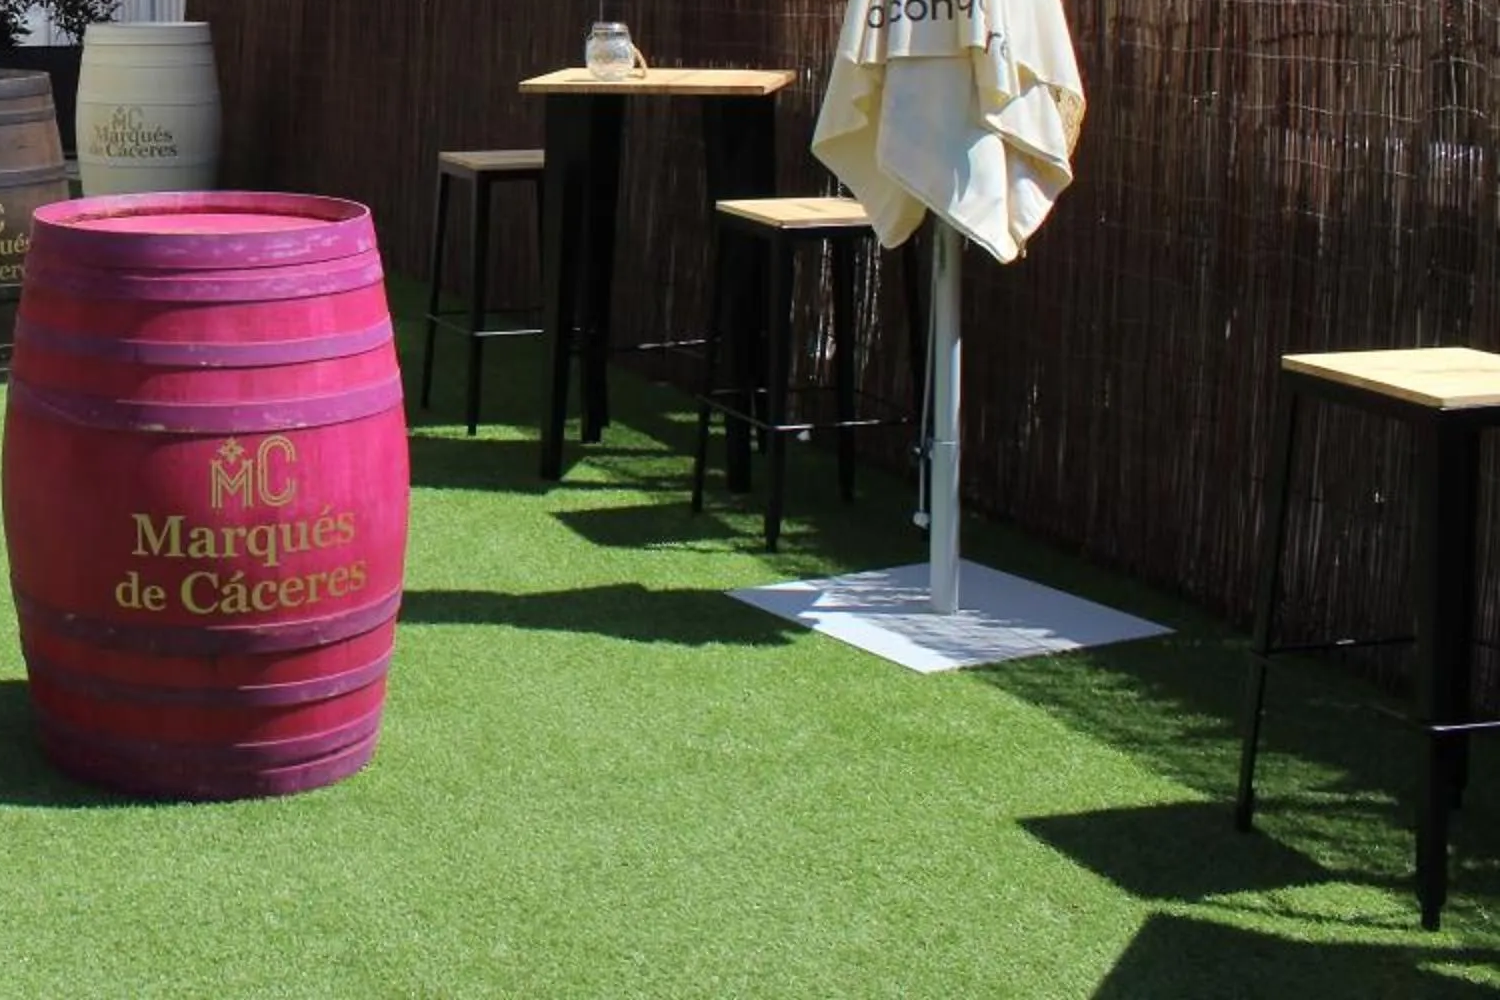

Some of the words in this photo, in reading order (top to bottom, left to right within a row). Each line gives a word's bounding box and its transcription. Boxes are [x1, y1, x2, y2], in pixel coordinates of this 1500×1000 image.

[211, 434, 297, 509] MC
[131, 504, 357, 567] Marqués
[114, 571, 167, 611] de
[180, 559, 367, 615] Cáceres
